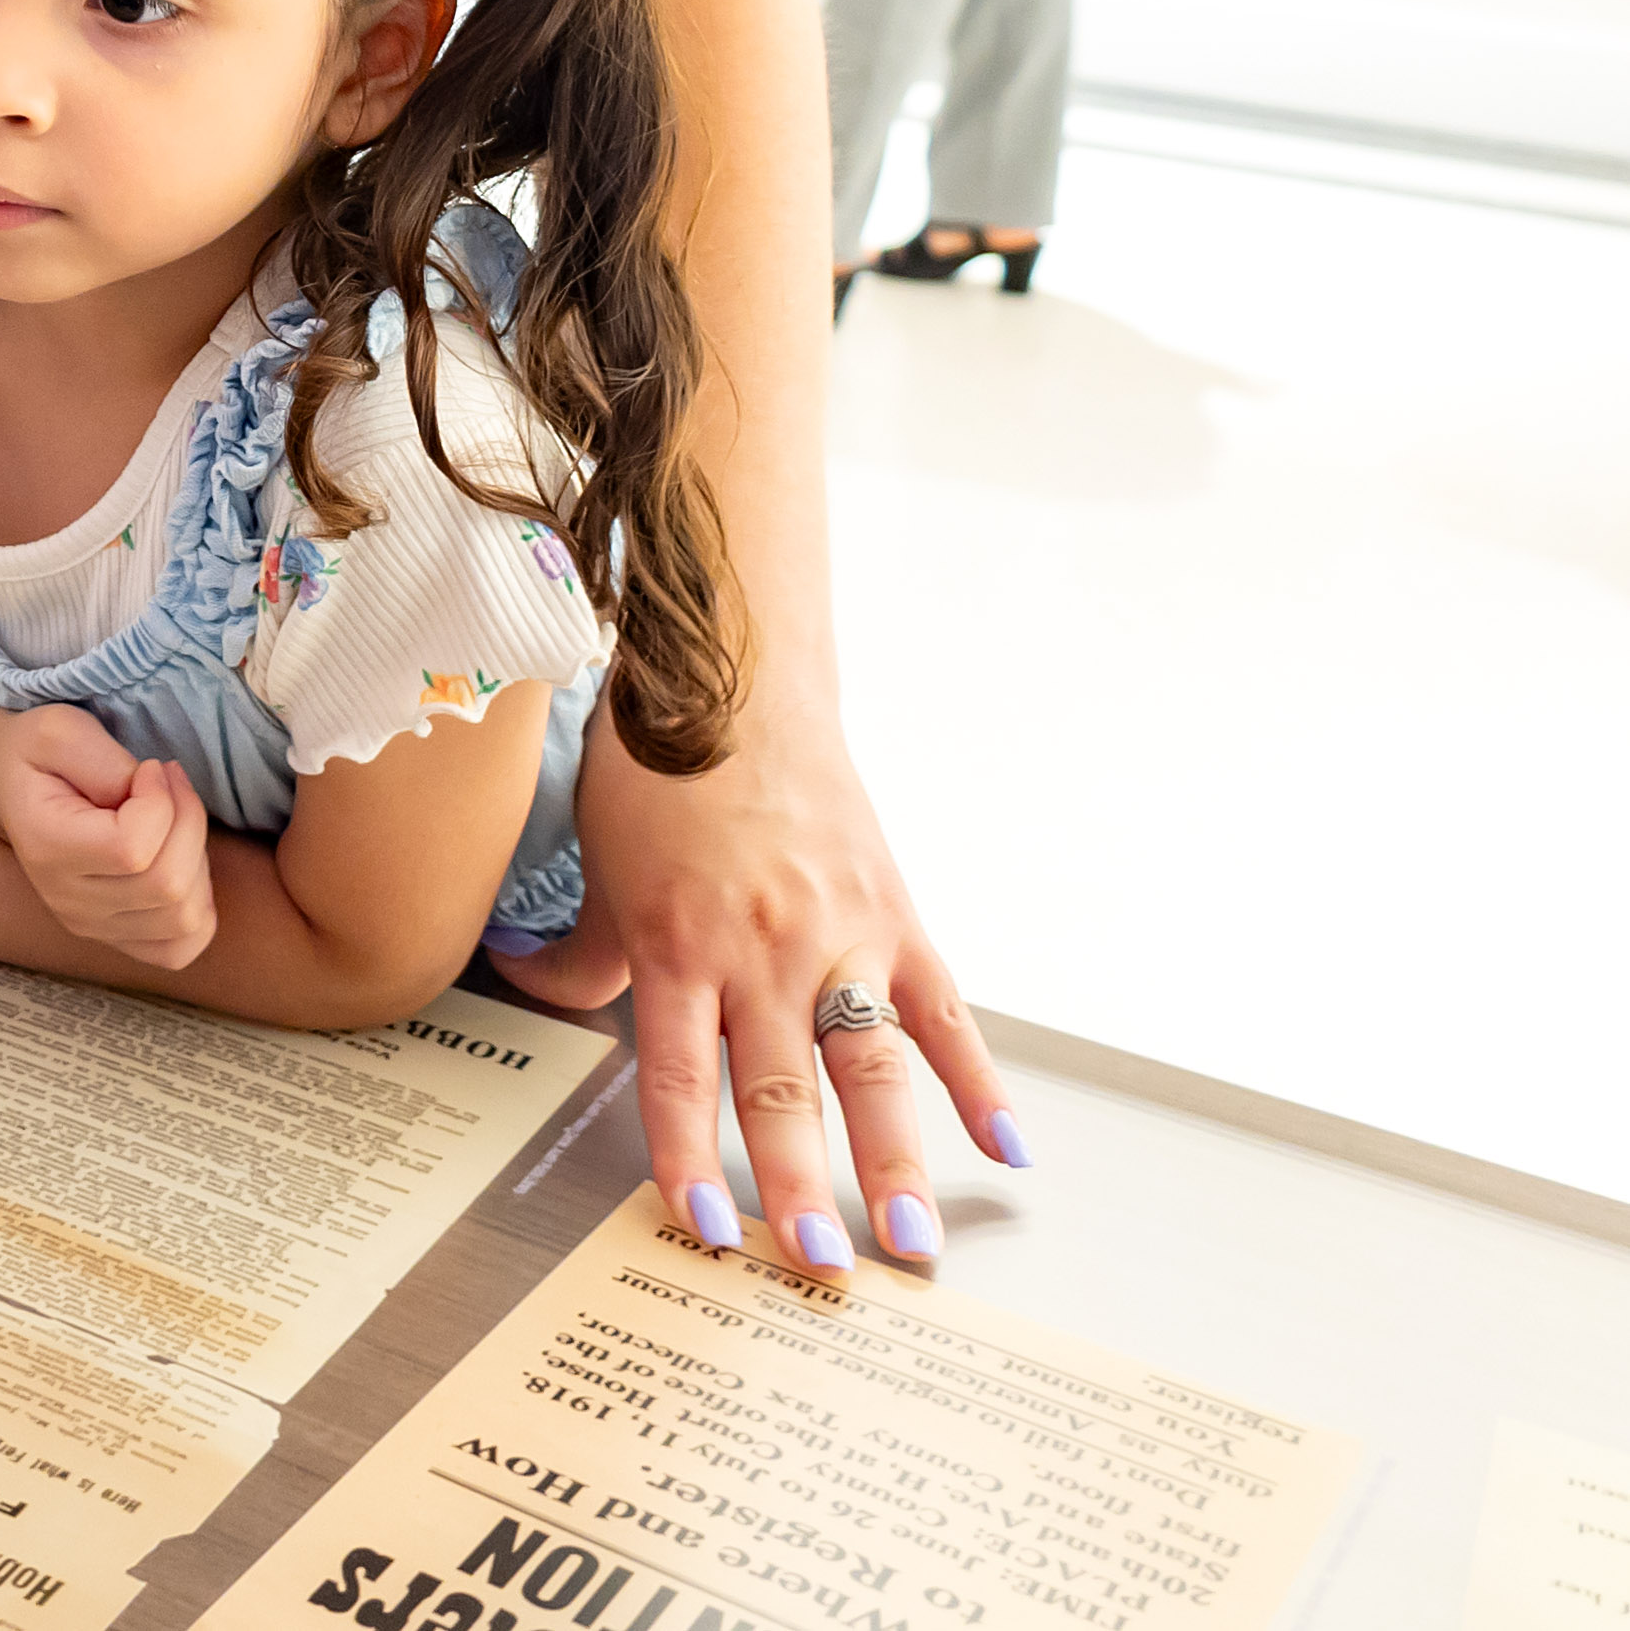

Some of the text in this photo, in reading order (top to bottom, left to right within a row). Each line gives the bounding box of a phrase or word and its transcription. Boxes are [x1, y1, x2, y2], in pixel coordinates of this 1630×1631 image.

[653, 1225, 1236, 1459] You cannot vote unless you
[519, 1370, 615, 1422] 1918.
[610, 1270, 1211, 1512] Don't fail to register and do your
[750, 1294, 1276, 1500] duty as American citizens.
[1139, 1378, 1304, 1447] register.
[573, 1311, 1231, 1583] State and County Tax Collector,
[627, 1413, 682, 1449] 11,
[27, 1457, 73, 1482] what
[75, 1477, 97, 1494] is
[449, 1435, 590, 1507] How
[537, 1349, 1151, 1611] PLACE: County Court House,
[552, 1332, 1215, 1605] 20th and Ave. H, at the office of the
[687, 1442, 771, 1484] July
[777, 1478, 819, 1503] to
[98, 1487, 143, 1514] Here
[593, 1495, 707, 1552] and
[828, 1499, 879, 1530] 26
[1025, 1462, 1243, 1560] first floor.
[634, 1462, 986, 1622] to Register.
[888, 1524, 986, 1573] June
